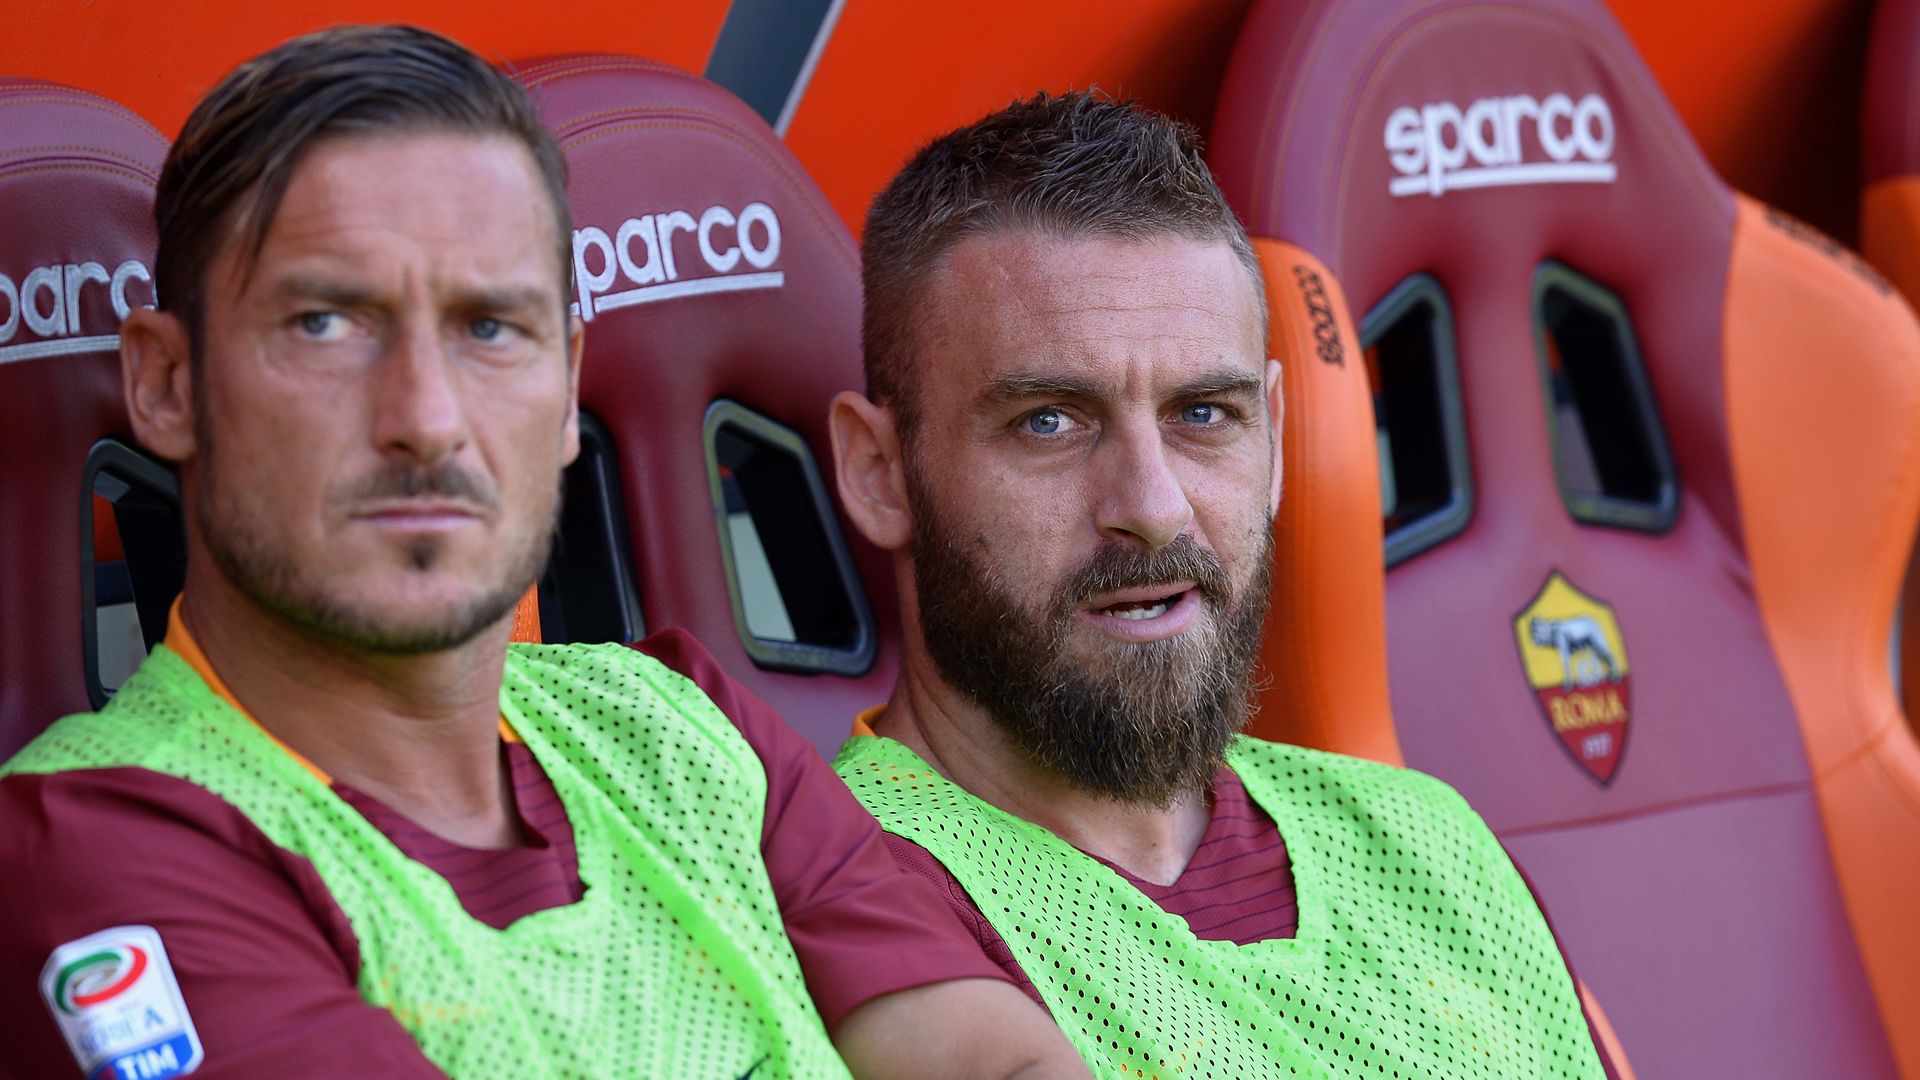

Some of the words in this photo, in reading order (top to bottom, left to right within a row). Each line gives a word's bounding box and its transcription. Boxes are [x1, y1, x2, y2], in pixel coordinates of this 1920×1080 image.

[1384, 93, 1615, 196] sparco
[571, 202, 783, 322] parco
[116, 1043, 179, 1080] TIM
